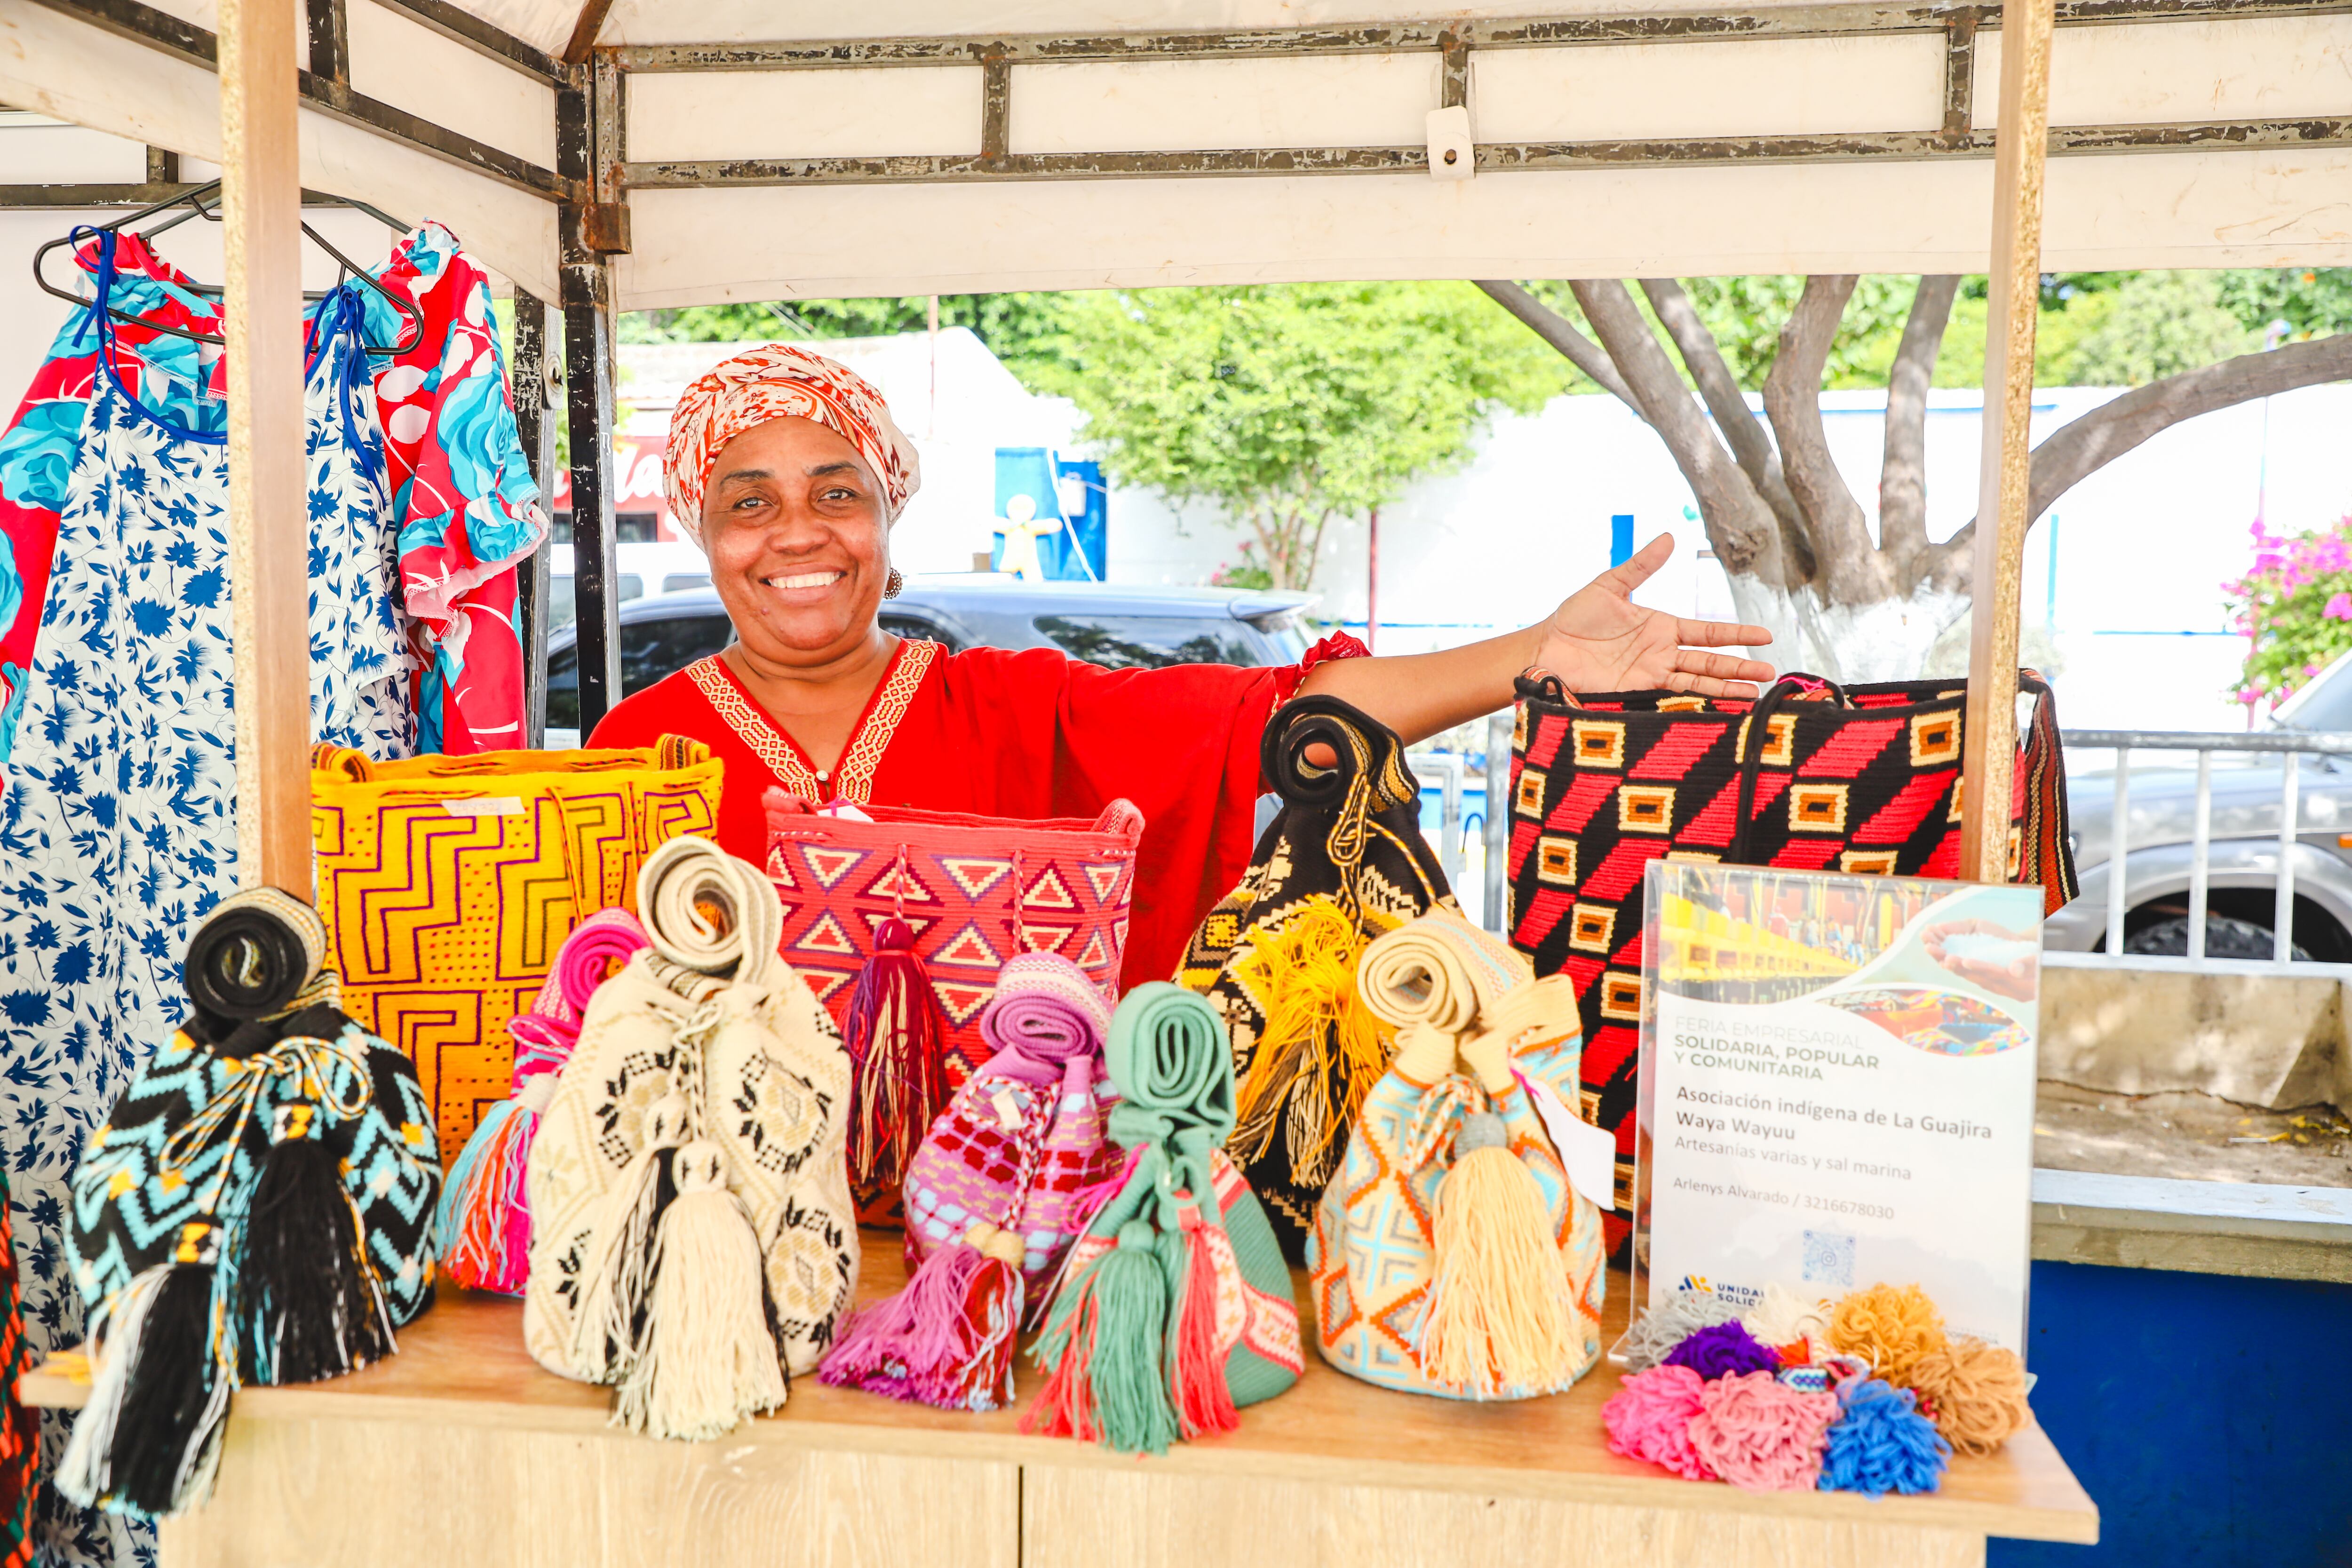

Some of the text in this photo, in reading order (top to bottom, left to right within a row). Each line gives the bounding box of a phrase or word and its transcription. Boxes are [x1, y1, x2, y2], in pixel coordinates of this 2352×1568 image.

[1676, 1016, 1865, 1050] FERIA EMPRESARIAL
[1674, 1035, 1879, 1069] SOLIDARIA, POPULAR
[1674, 1051, 1823, 1080] Y COMUNITARIA
[1677, 1086, 1992, 1139] Asociación indígena de La Guajira
[1677, 1112, 1796, 1140] Waya Wayuu
[1675, 1137, 1911, 1180] Artesanías varias y sal marina
[1673, 1178, 1893, 1219] Arlenys Alvarado / 3216678030
[1717, 1283, 1764, 1297] UNIDA
[1717, 1293, 1762, 1306] SOLID
